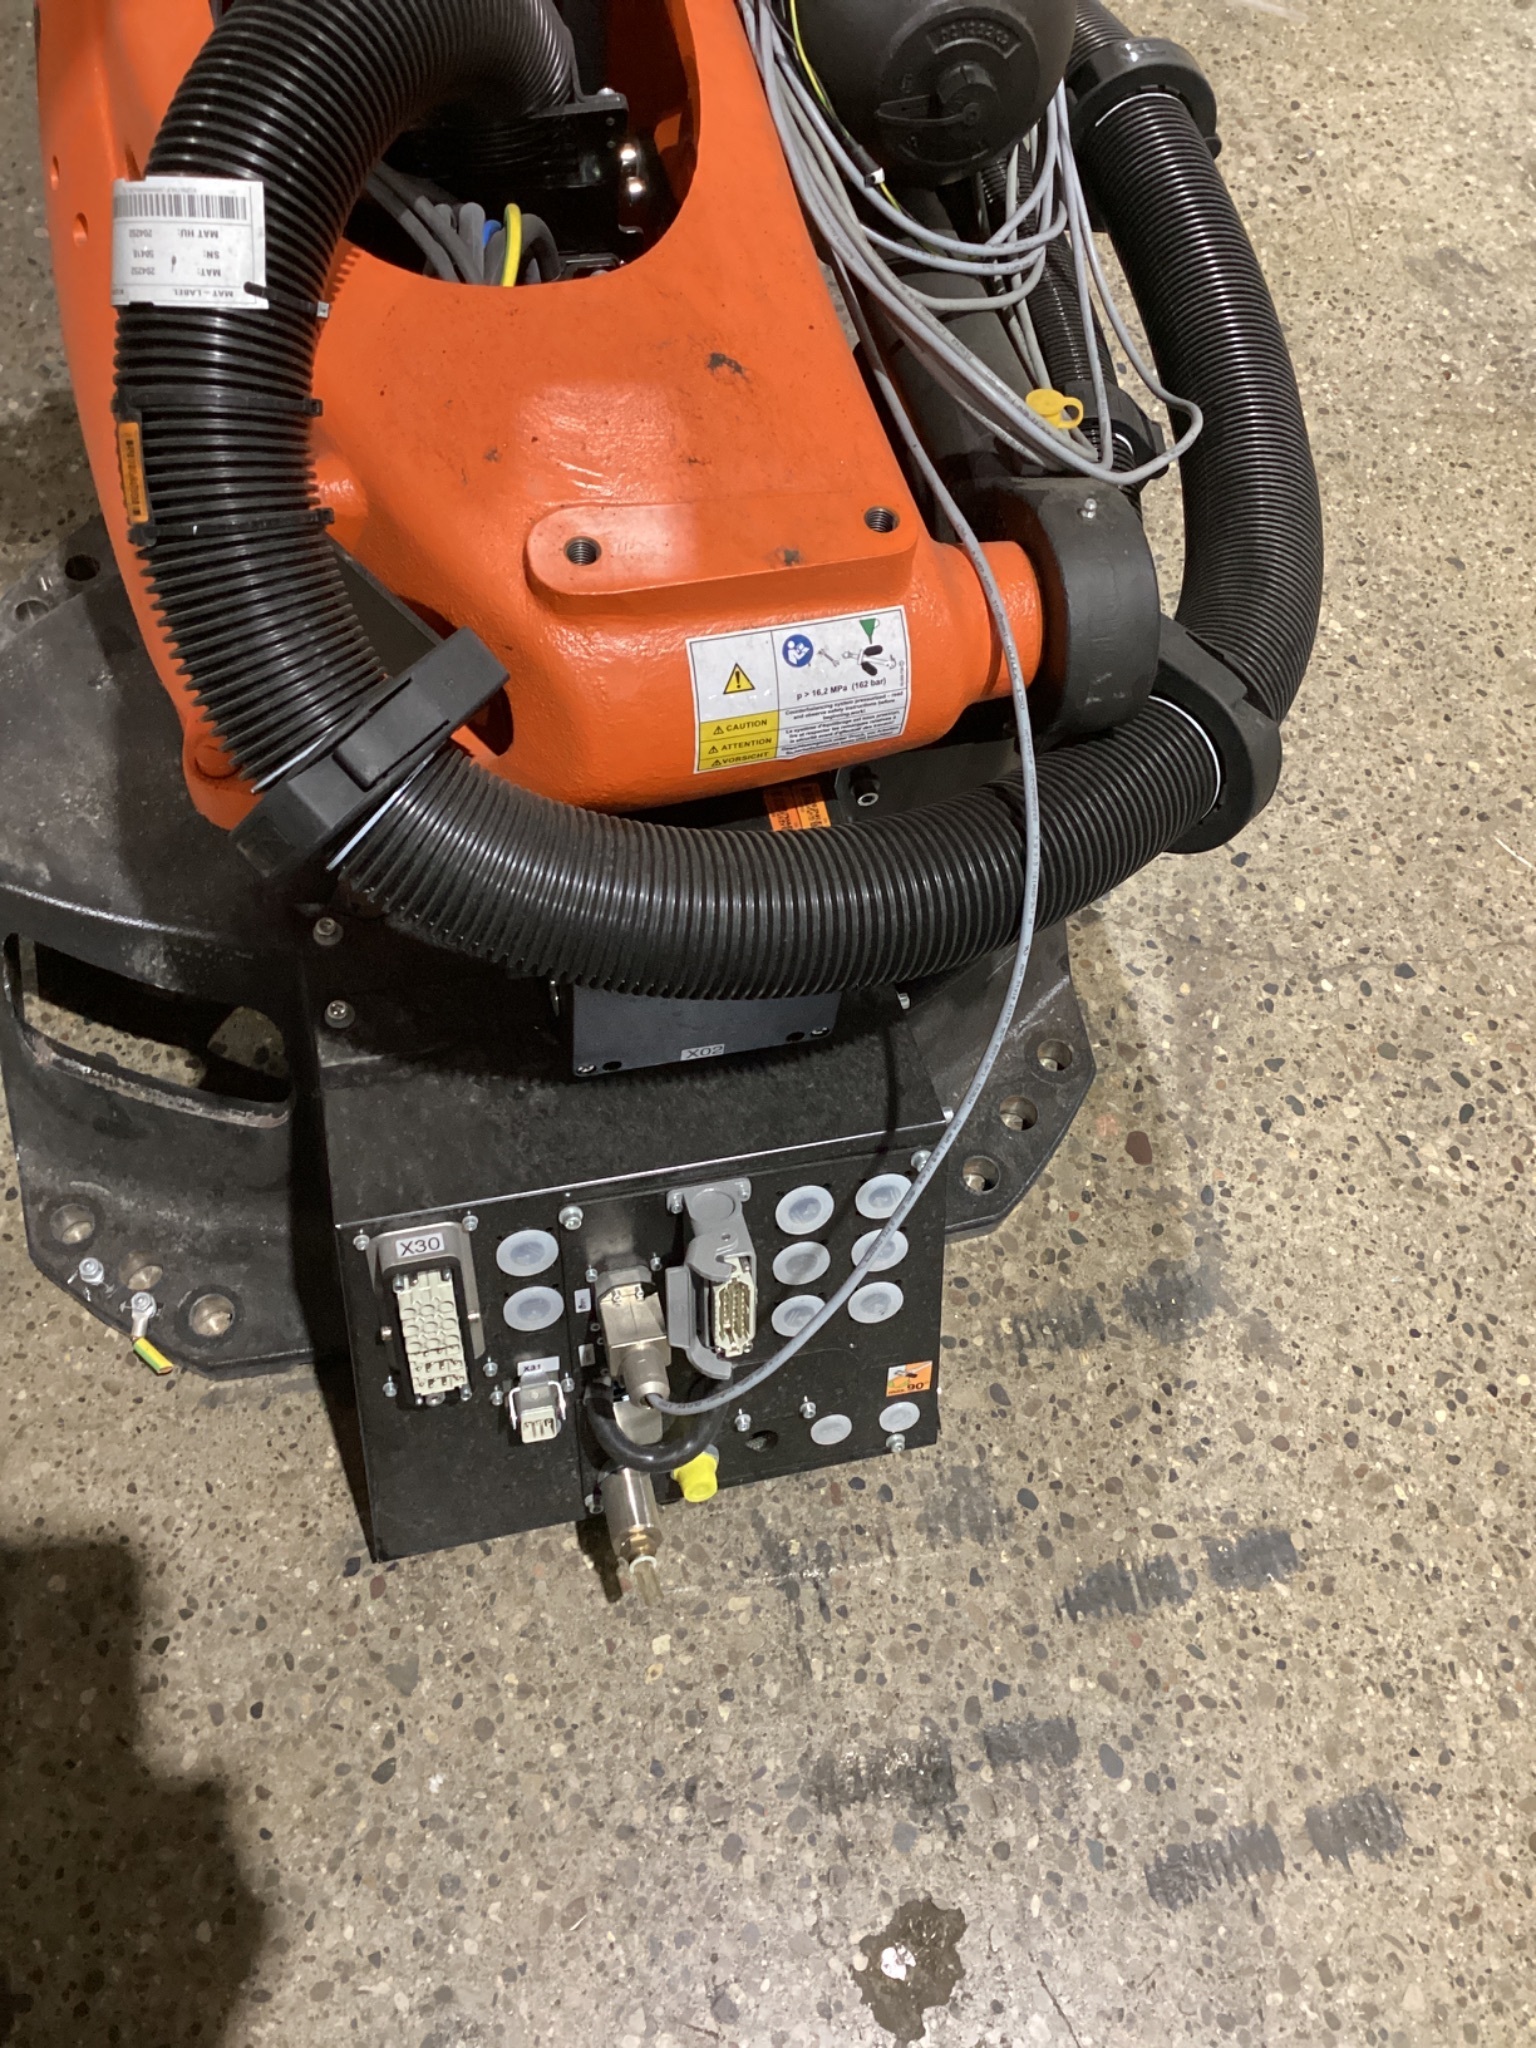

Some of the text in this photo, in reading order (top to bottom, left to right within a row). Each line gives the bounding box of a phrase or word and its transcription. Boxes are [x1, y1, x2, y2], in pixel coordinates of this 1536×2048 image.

[198, 230, 219, 239] MAT
[197, 268, 221, 277] MAT:
[830, 684, 848, 693] MPa
[851, 681, 869, 692] (162
[870, 677, 886, 687] bar)
[726, 719, 768, 732] CAUTION
[721, 737, 773, 751] ATTENTION
[722, 751, 769, 764] VORSICHT
[687, 1045, 723, 1059] X02
[400, 1237, 440, 1256] X30
